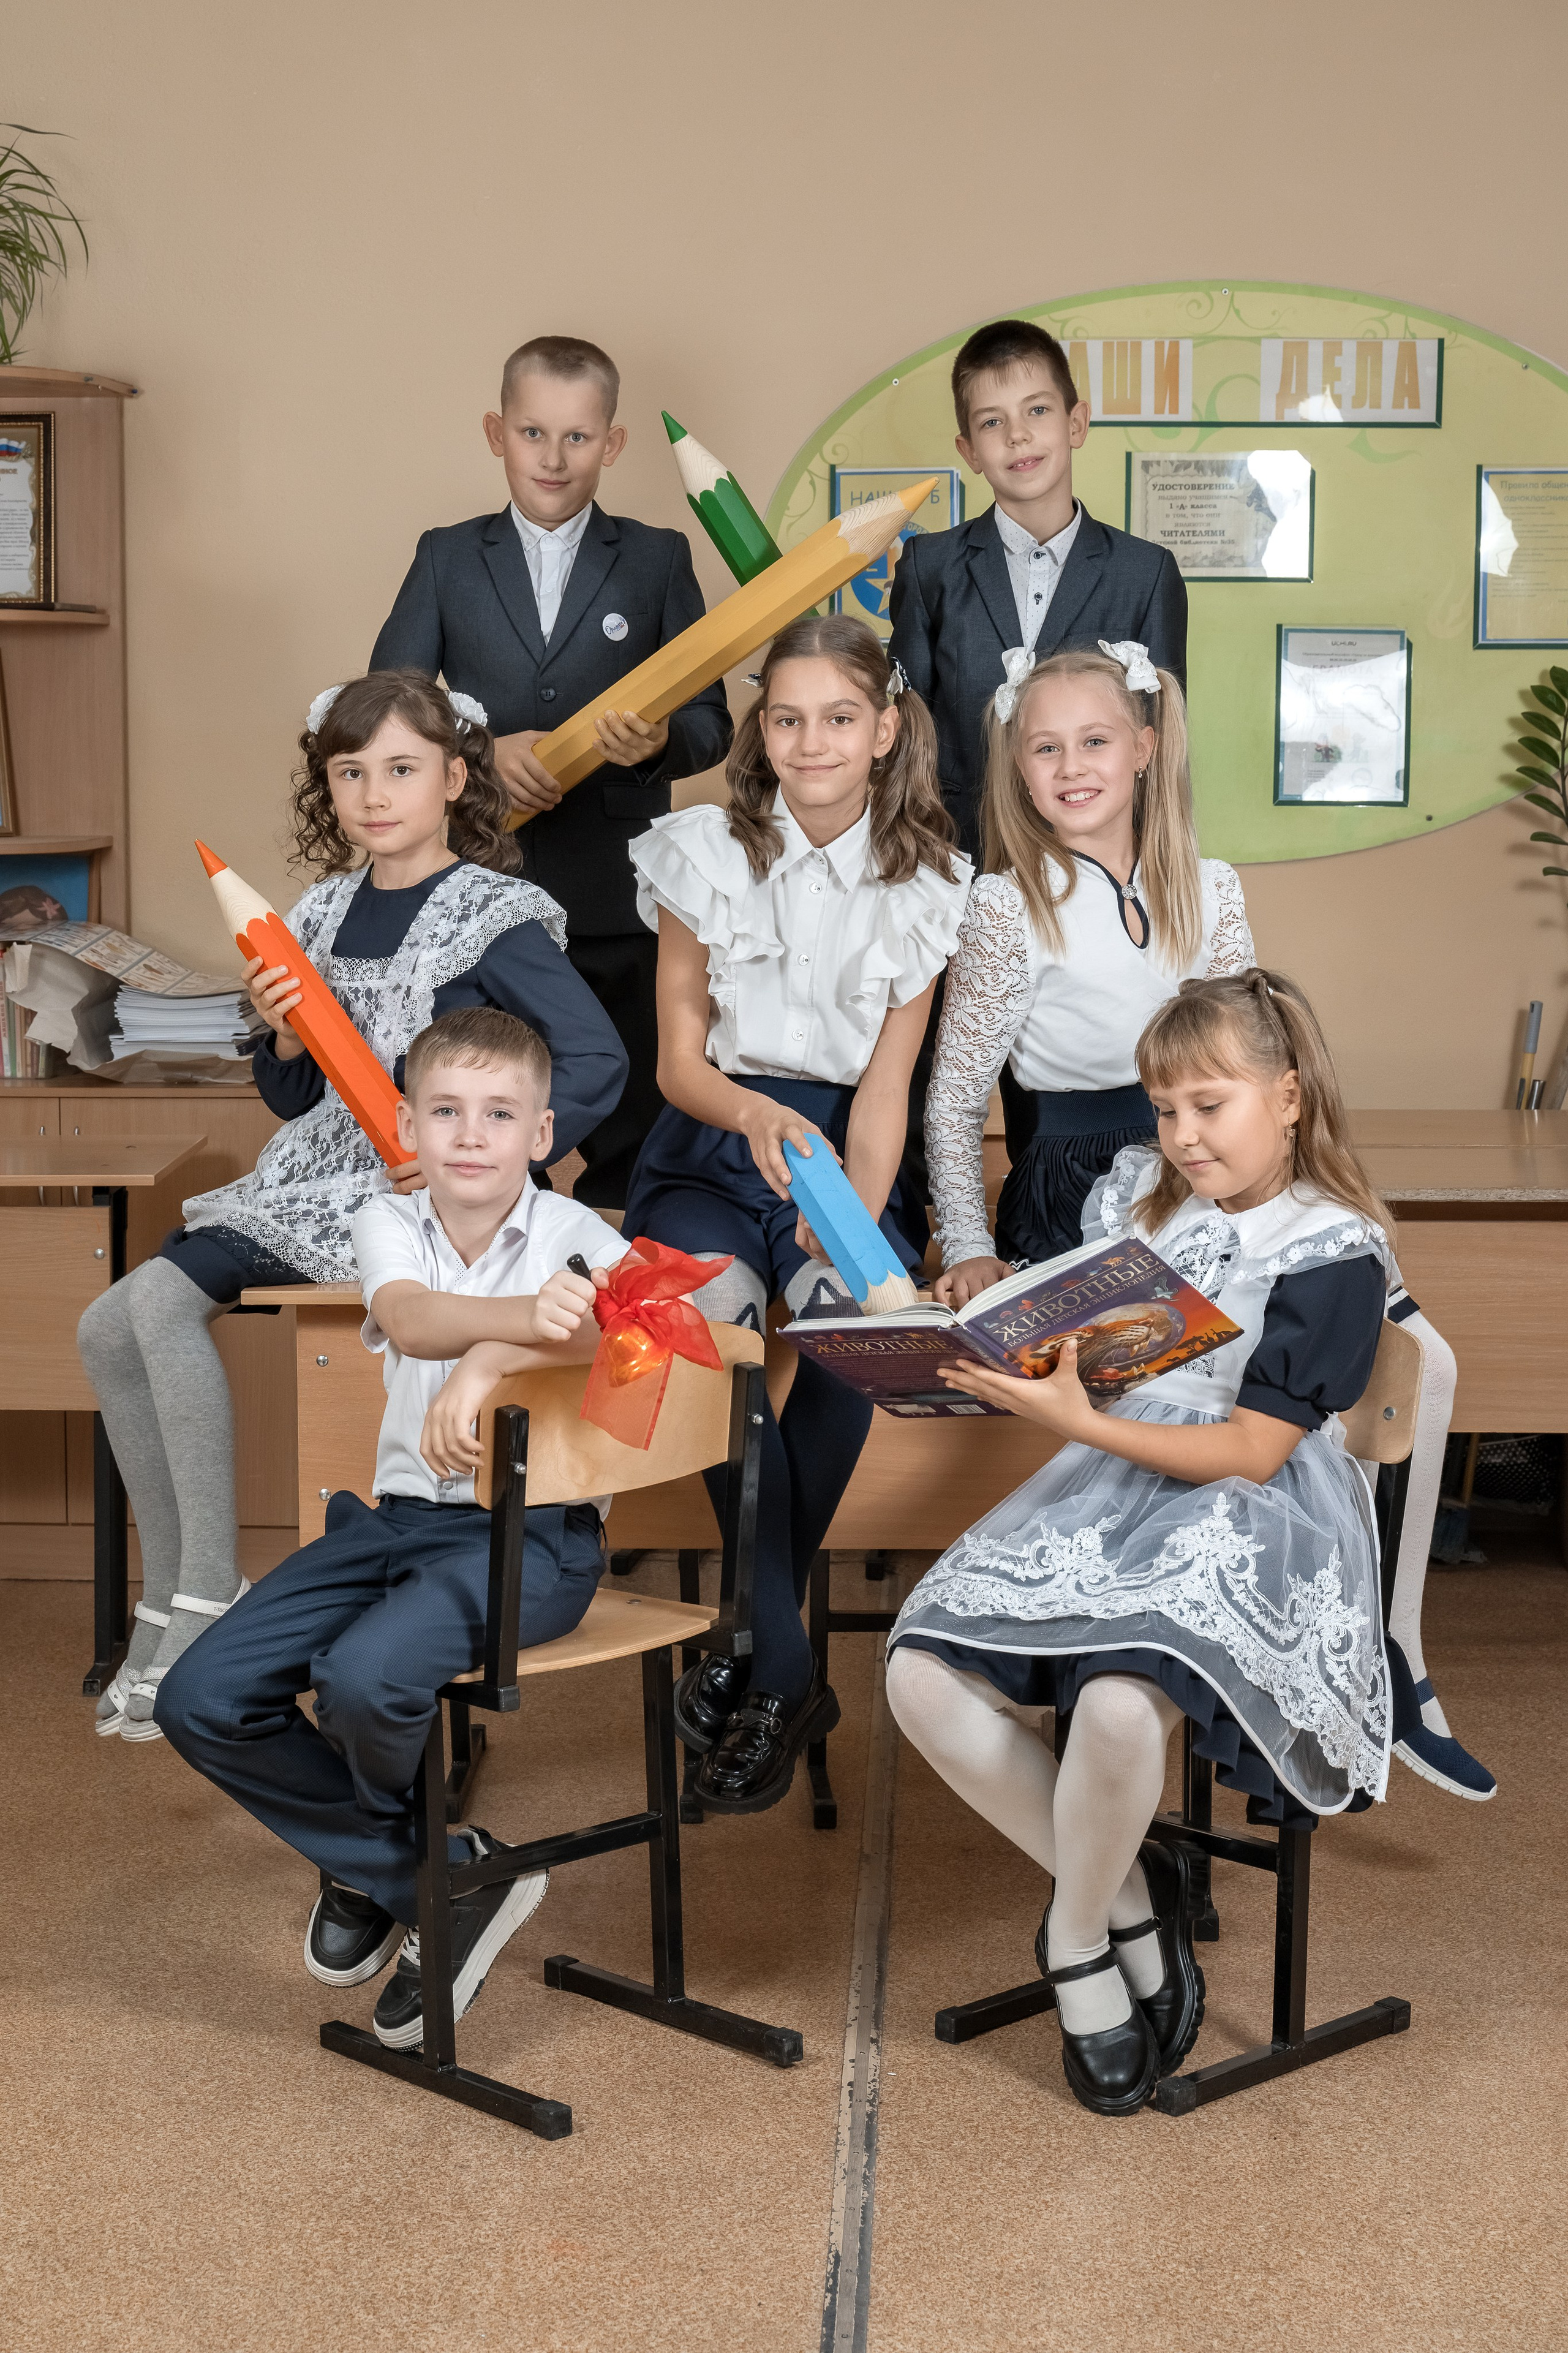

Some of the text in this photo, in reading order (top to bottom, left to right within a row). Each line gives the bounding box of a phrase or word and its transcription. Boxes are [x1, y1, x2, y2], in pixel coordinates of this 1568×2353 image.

[1069, 341, 1420, 420] АШИ ДЕЛА
[993, 1253, 1160, 1343] ЖИВОТНЫЕ
[1008, 1264, 1166, 1348] БОЛЬШАЯ ДЕТСКАЯ ЭНЦИКЛОПЕДИЯ
[816, 1340, 953, 1354] ЖИВОТНЫЕ
